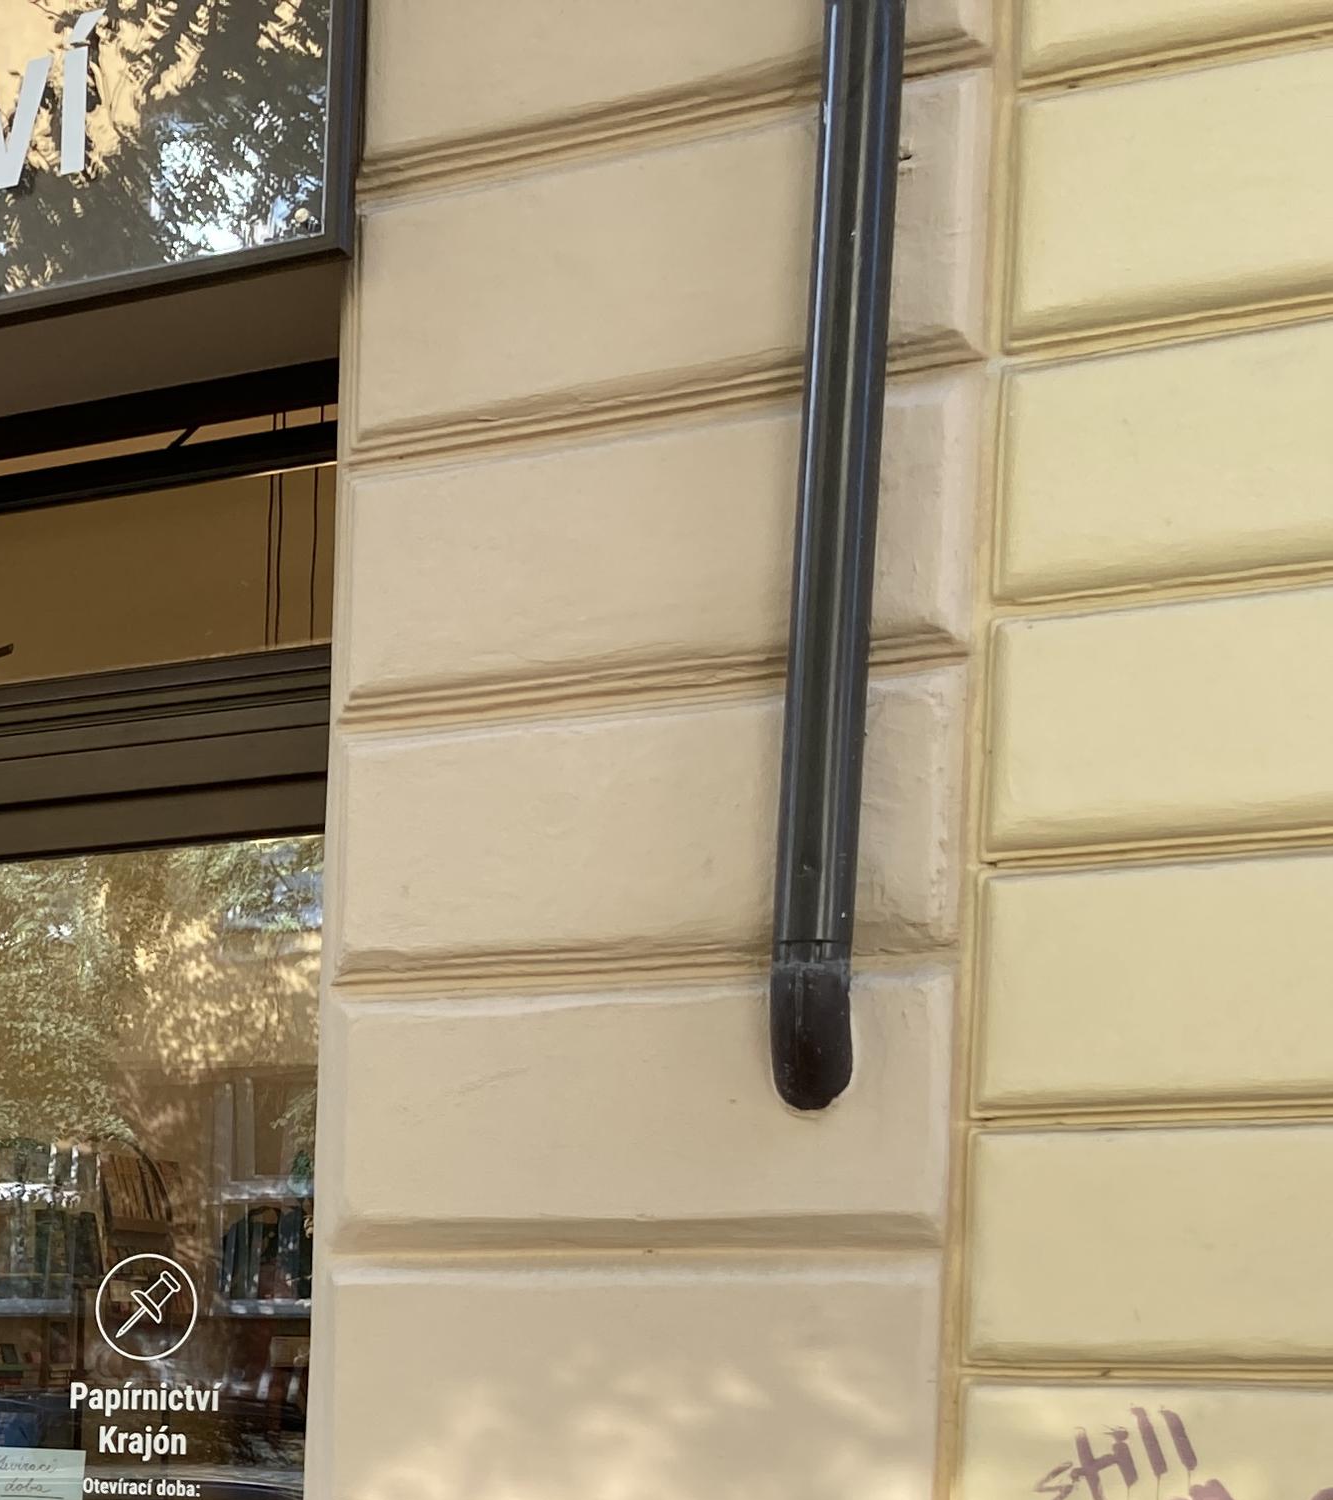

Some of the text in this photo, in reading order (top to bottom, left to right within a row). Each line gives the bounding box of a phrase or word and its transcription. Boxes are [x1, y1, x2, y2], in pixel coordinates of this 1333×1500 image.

[69, 1381, 220, 1416] Papírnictví
[98, 1425, 187, 1461] Krajón
[82, 1477, 201, 1498] Otevírací doba:
